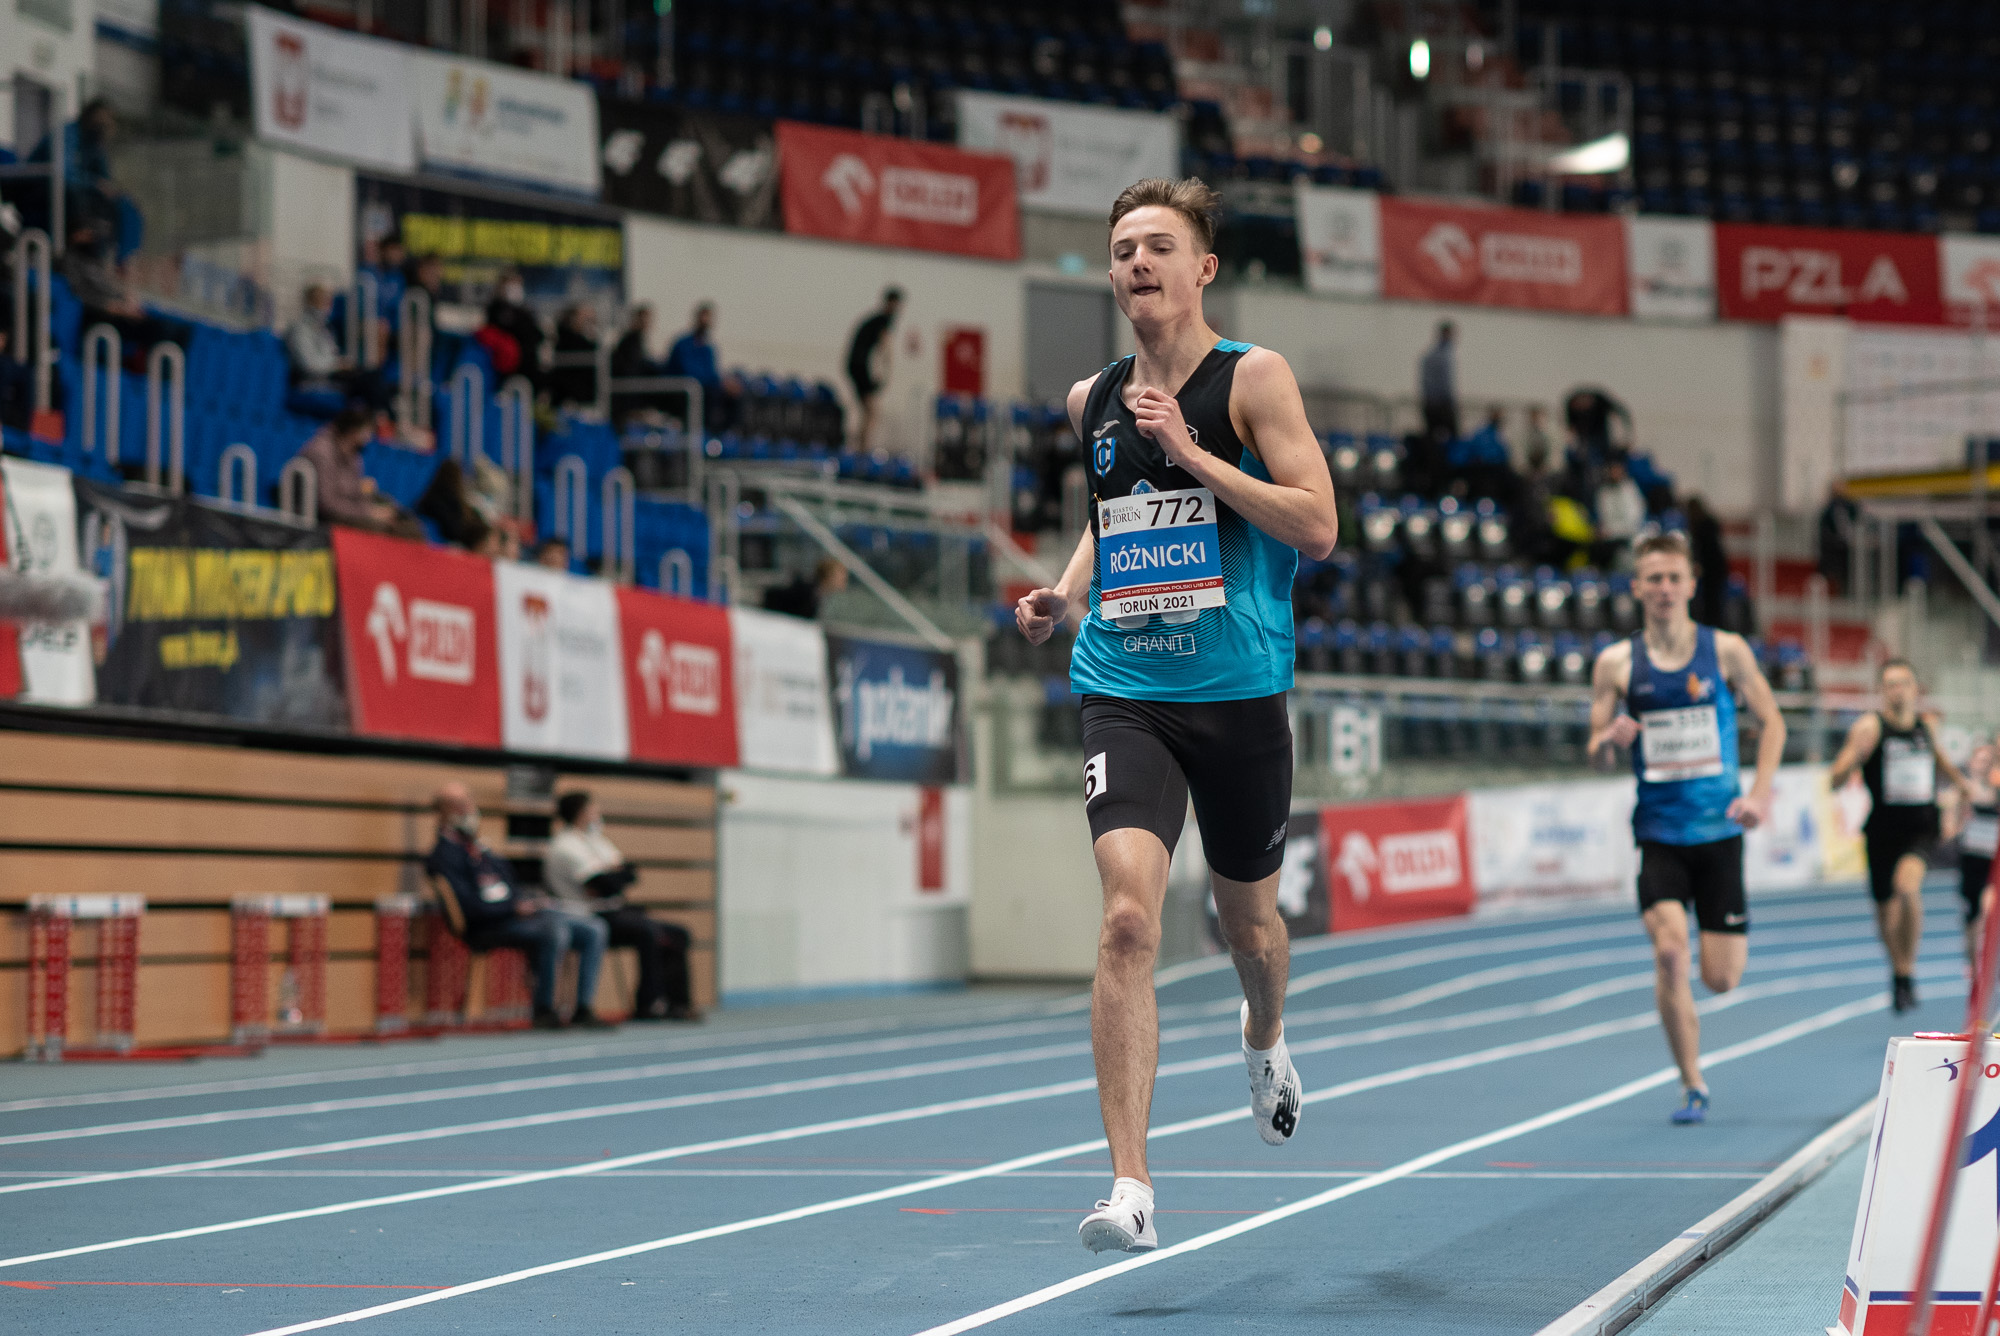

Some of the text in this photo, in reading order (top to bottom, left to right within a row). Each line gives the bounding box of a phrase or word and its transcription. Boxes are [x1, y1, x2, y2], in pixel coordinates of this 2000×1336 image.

[1741, 247, 1908, 304] PZLA
[1112, 506, 1134, 514] MIASTO
[1112, 508, 1141, 525] TORUŃ
[1147, 496, 1205, 527] 772
[1110, 541, 1206, 574] RÓŻNICKI
[1131, 586, 1171, 595] MISTRZOSTWA
[1119, 595, 1195, 614] TORUŃ 2021
[1123, 634, 1186, 653] GRANIT
[1085, 763, 1097, 802] 6
